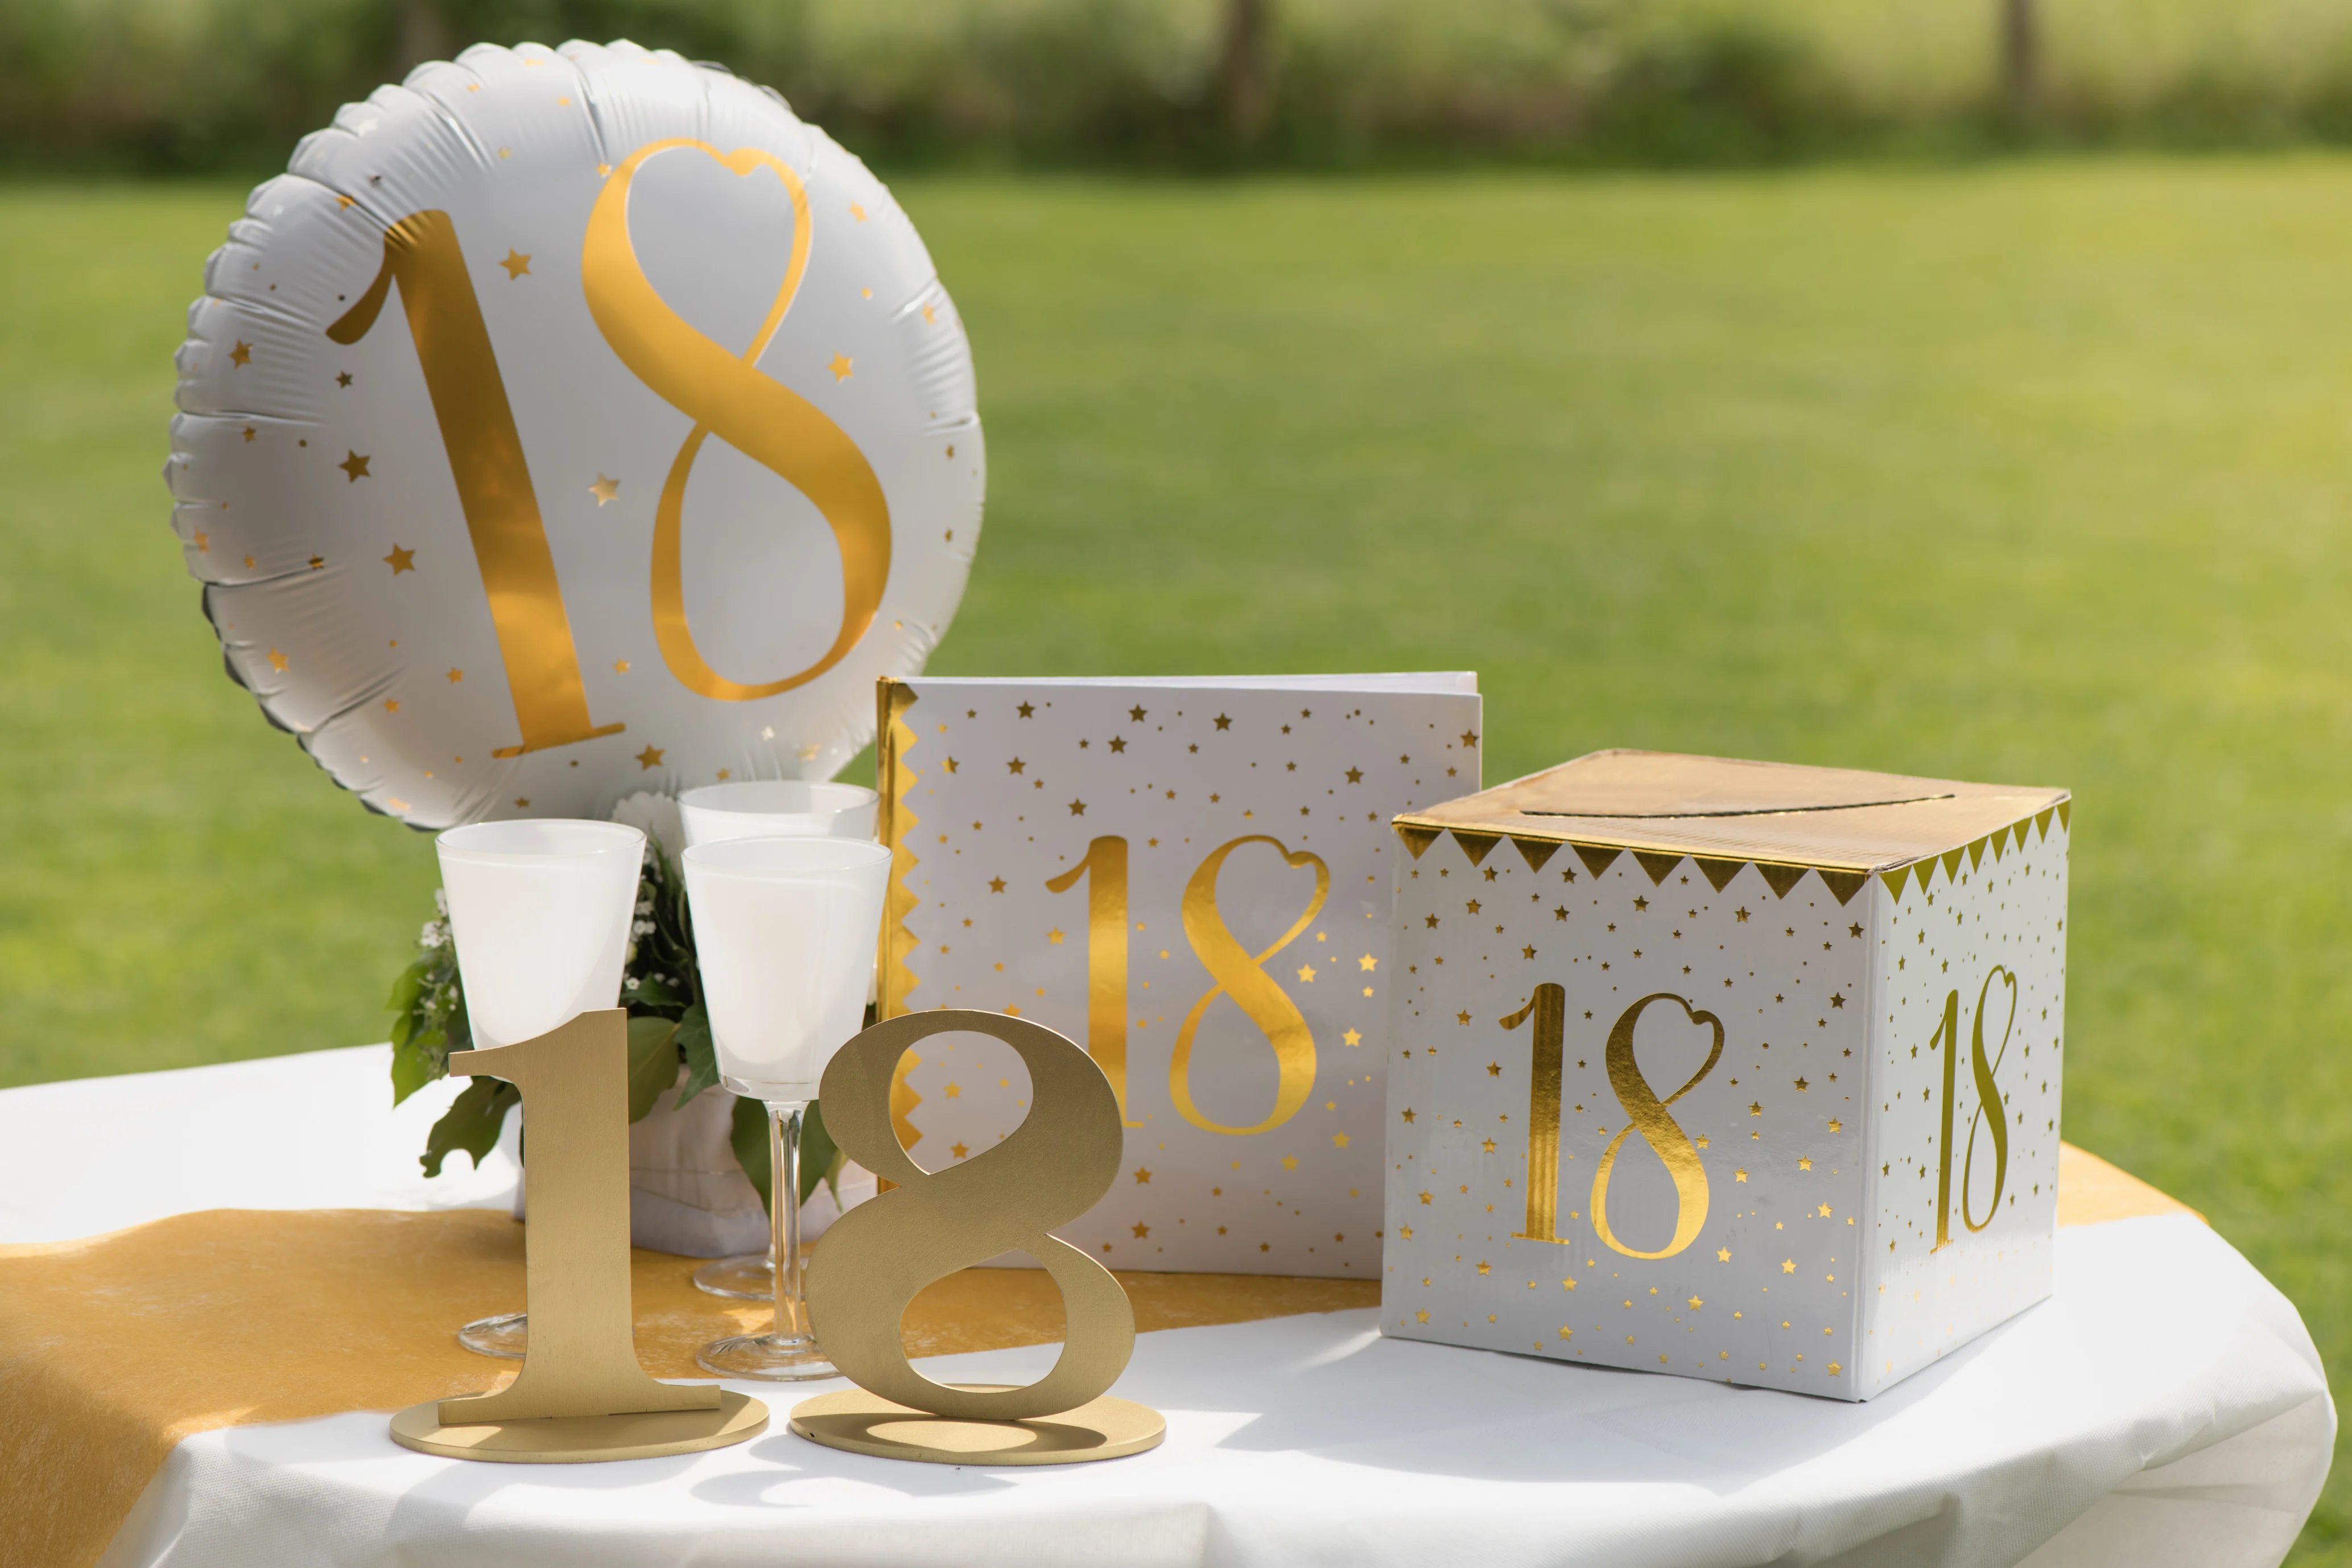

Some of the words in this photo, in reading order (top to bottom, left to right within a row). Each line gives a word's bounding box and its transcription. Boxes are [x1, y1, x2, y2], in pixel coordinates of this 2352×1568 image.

[325, 137, 892, 758] 18
[1045, 835, 1330, 1136] 18
[1499, 983, 1725, 1260] 18
[1929, 964, 2017, 1255] 18
[438, 1007, 1136, 1425] 18
